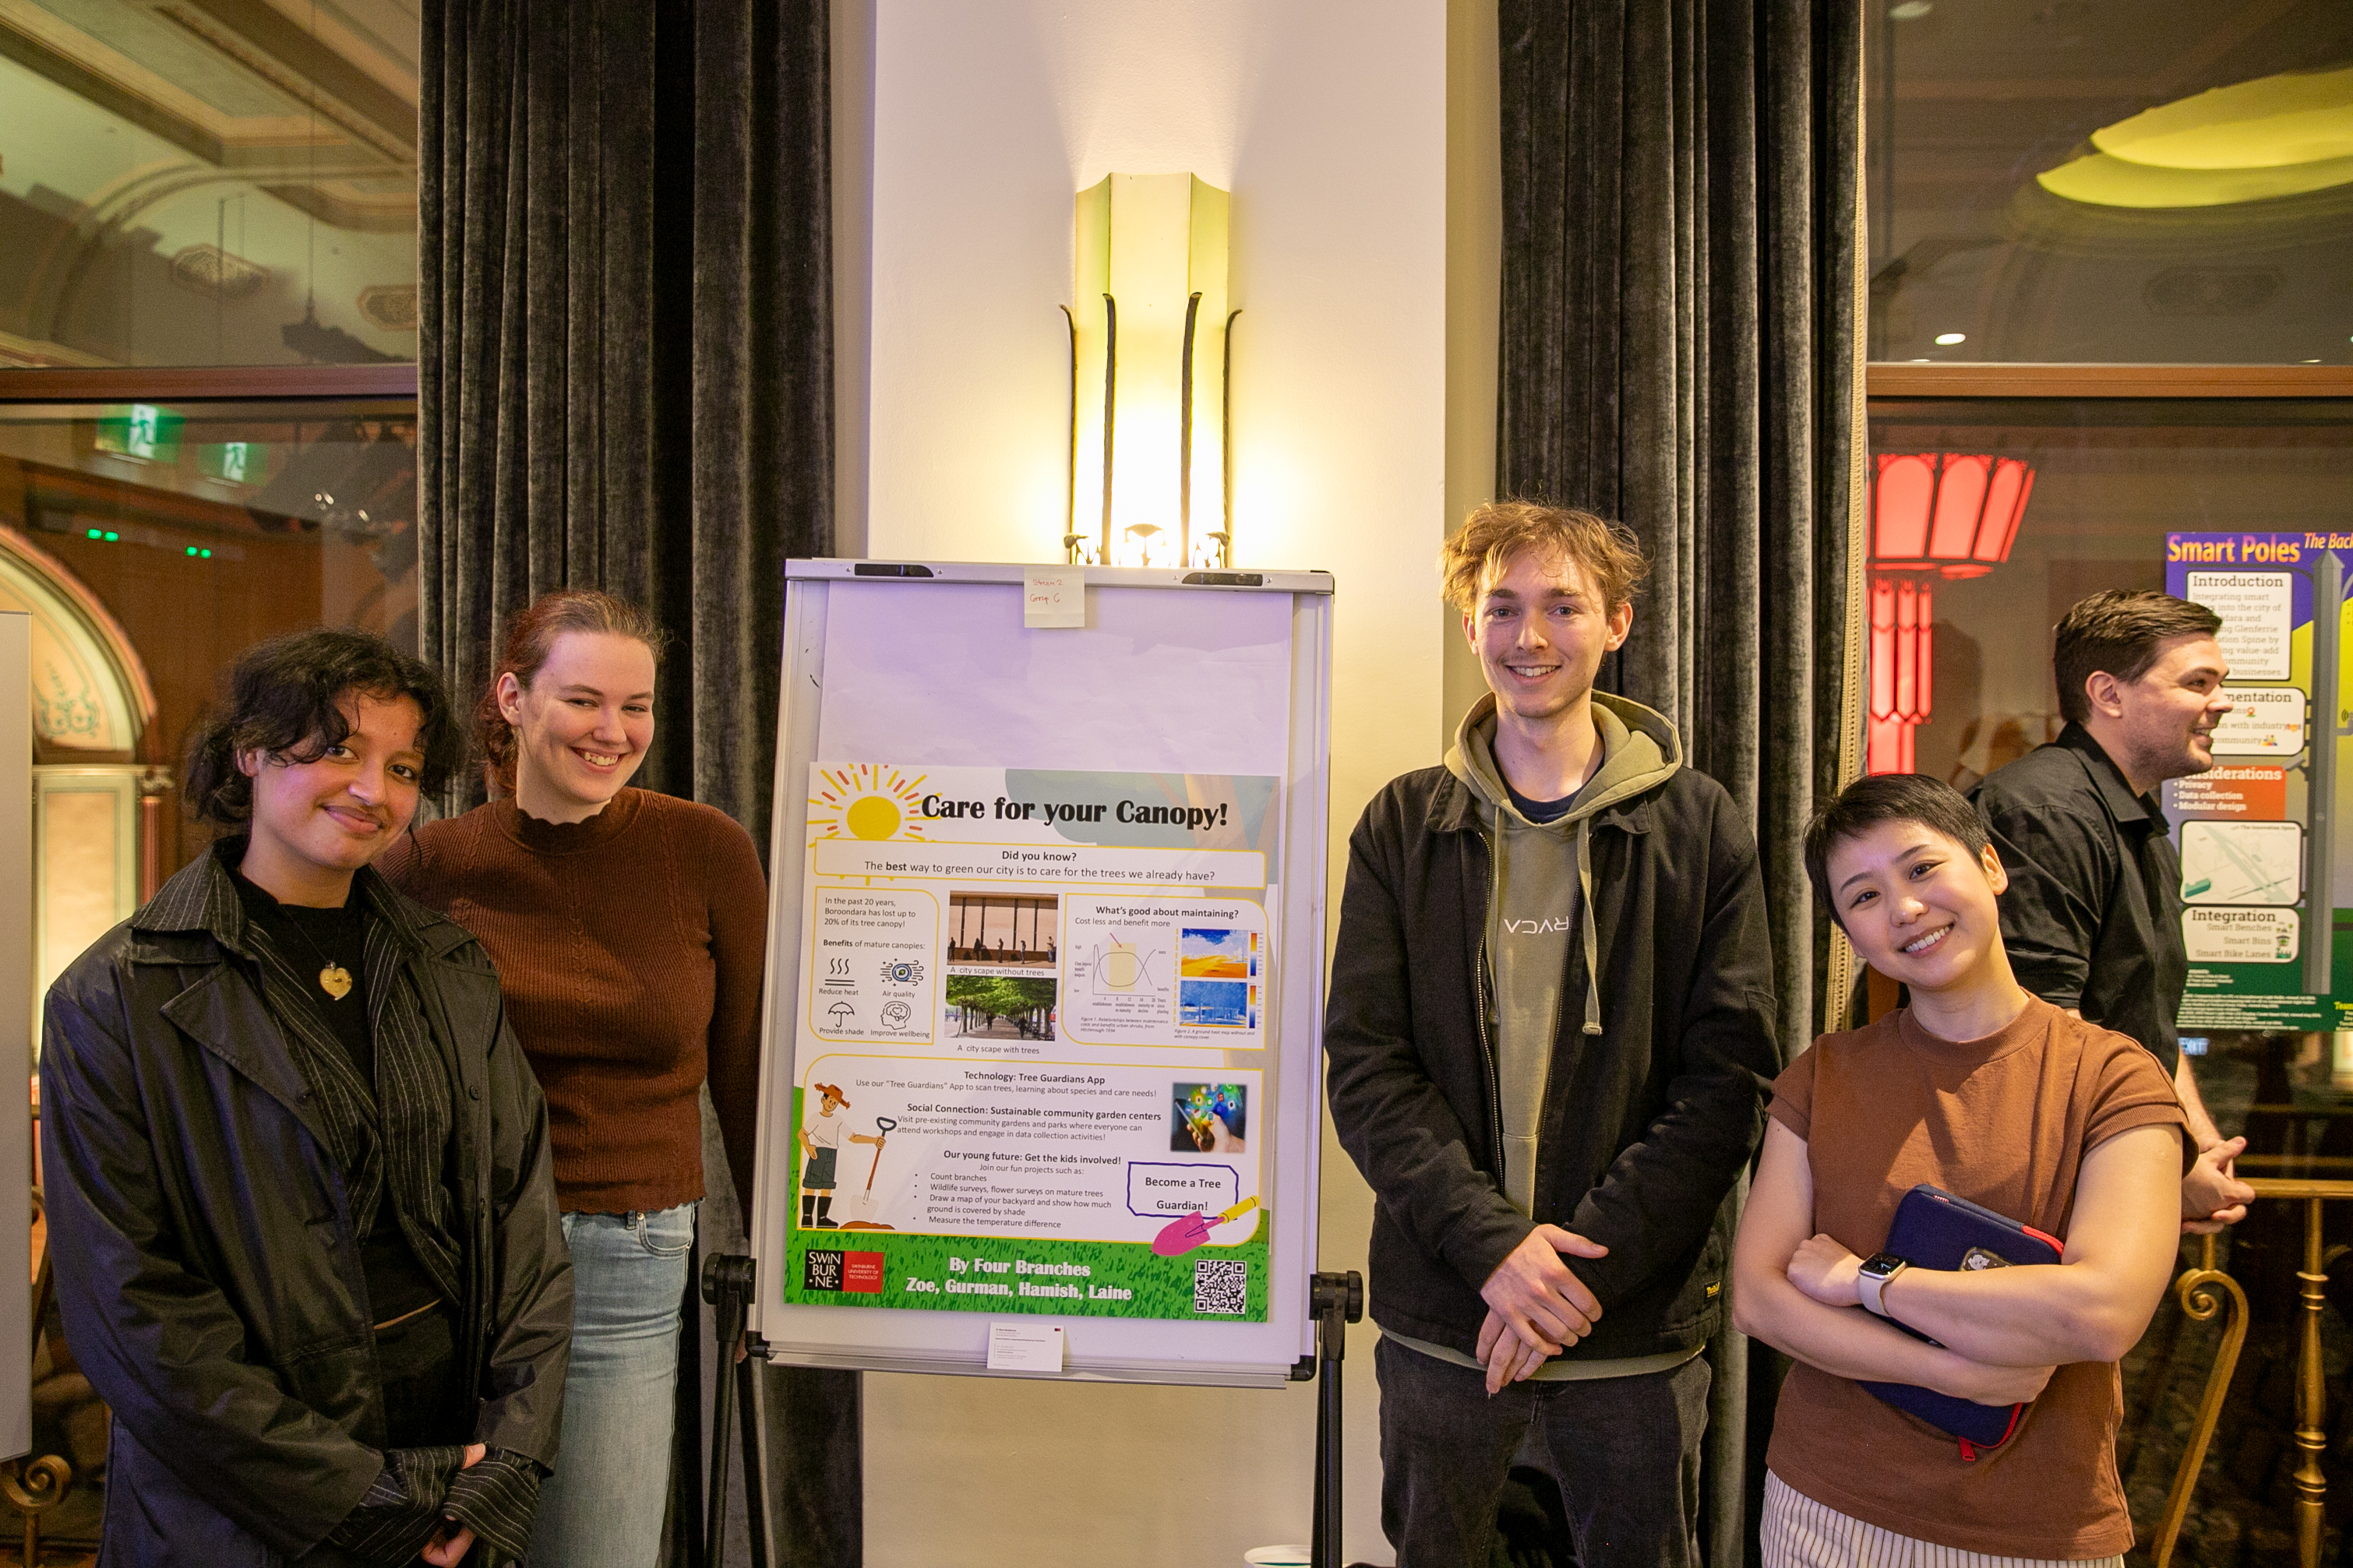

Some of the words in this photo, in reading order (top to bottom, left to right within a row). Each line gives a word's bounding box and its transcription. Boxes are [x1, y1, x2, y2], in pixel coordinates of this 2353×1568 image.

[2168, 534, 2235, 562] Smart
[2242, 535, 2301, 562] Poles
[2304, 533, 2326, 549] The
[2192, 575, 2284, 587] Introduction
[2192, 593, 2242, 601] Integrating
[2254, 604, 2270, 613] city
[2234, 625, 2278, 633] Glenferrie
[2241, 636, 2267, 645] Spine
[2268, 636, 2280, 645] by
[2235, 647, 2279, 655] value-add
[2224, 657, 2269, 667] ommunity
[2232, 668, 2282, 676] businesses.
[2230, 721, 2249, 730] with
[2252, 721, 2287, 731] industry
[2178, 780, 2214, 791] Privacy
[2178, 791, 2199, 800] Data
[2200, 791, 2244, 800] collection
[2178, 802, 2216, 810] Modular
[2217, 802, 2247, 812] design
[922, 795, 985, 819] Care
[994, 797, 1035, 820] for
[1043, 804, 1106, 826] your
[1117, 800, 1227, 831] Canopy!
[1002, 851, 1019, 860] Did
[1021, 853, 1040, 862] you
[1043, 851, 1077, 862] know?
[864, 861, 883, 871] The
[885, 861, 907, 872] best
[910, 865, 930, 874] way
[933, 864, 943, 872] to
[945, 865, 973, 875] green
[996, 865, 1014, 876] city
[1016, 865, 1025, 876] is
[1027, 867, 1037, 876] to
[1064, 866, 1078, 876] for
[1081, 868, 1098, 877] the
[1100, 869, 1126, 878] trees
[1145, 869, 1183, 882] already
[1186, 870, 1215, 881] have?
[834, 897, 846, 905] the
[824, 907, 866, 916] Boroondara
[1128, 907, 1151, 917] good
[1152, 907, 1179, 917] about
[1181, 908, 1239, 920] maintaining?
[2192, 910, 2276, 924] Integration
[877, 920, 905, 929] canopy!
[1124, 918, 1149, 927] benefit
[823, 939, 853, 947] Benefits
[2224, 950, 2243, 958] Bike
[898, 1031, 930, 1039] wellbeing
[964, 1071, 1016, 1083] Technology:
[1018, 1073, 1038, 1082] Tree
[1040, 1073, 1085, 1084] Guardians
[1087, 1076, 1106, 1086] App
[907, 1103, 933, 1112] Social
[935, 1104, 988, 1114] Connection:
[990, 1106, 1042, 1116] Sustainable
[1043, 1109, 1094, 1120] community
[1095, 1111, 1127, 1120] garden
[1128, 1112, 1162, 1121] centers
[944, 1150, 961, 1158] Our
[962, 1152, 990, 1161] young
[992, 1151, 1022, 1161] future:
[1025, 1153, 1041, 1162] Get
[1042, 1154, 1058, 1163] the
[1060, 1154, 1078, 1164] kids
[1080, 1155, 1121, 1165] involved!
[930, 1172, 952, 1181] Count
[954, 1173, 987, 1182] branches
[1145, 1176, 1187, 1187] Become
[1198, 1179, 1221, 1189] Tree
[1156, 1200, 1208, 1210] Guardian!
[812, 1263, 837, 1277] BUR
[949, 1256, 970, 1275] By
[973, 1257, 1011, 1274] Four
[1014, 1260, 1092, 1277] Branches
[905, 1277, 940, 1295] Zoe,
[944, 1278, 1014, 1298] Gurman,
[1018, 1281, 1084, 1301] Hamish,
[1088, 1284, 1132, 1301] Laine
